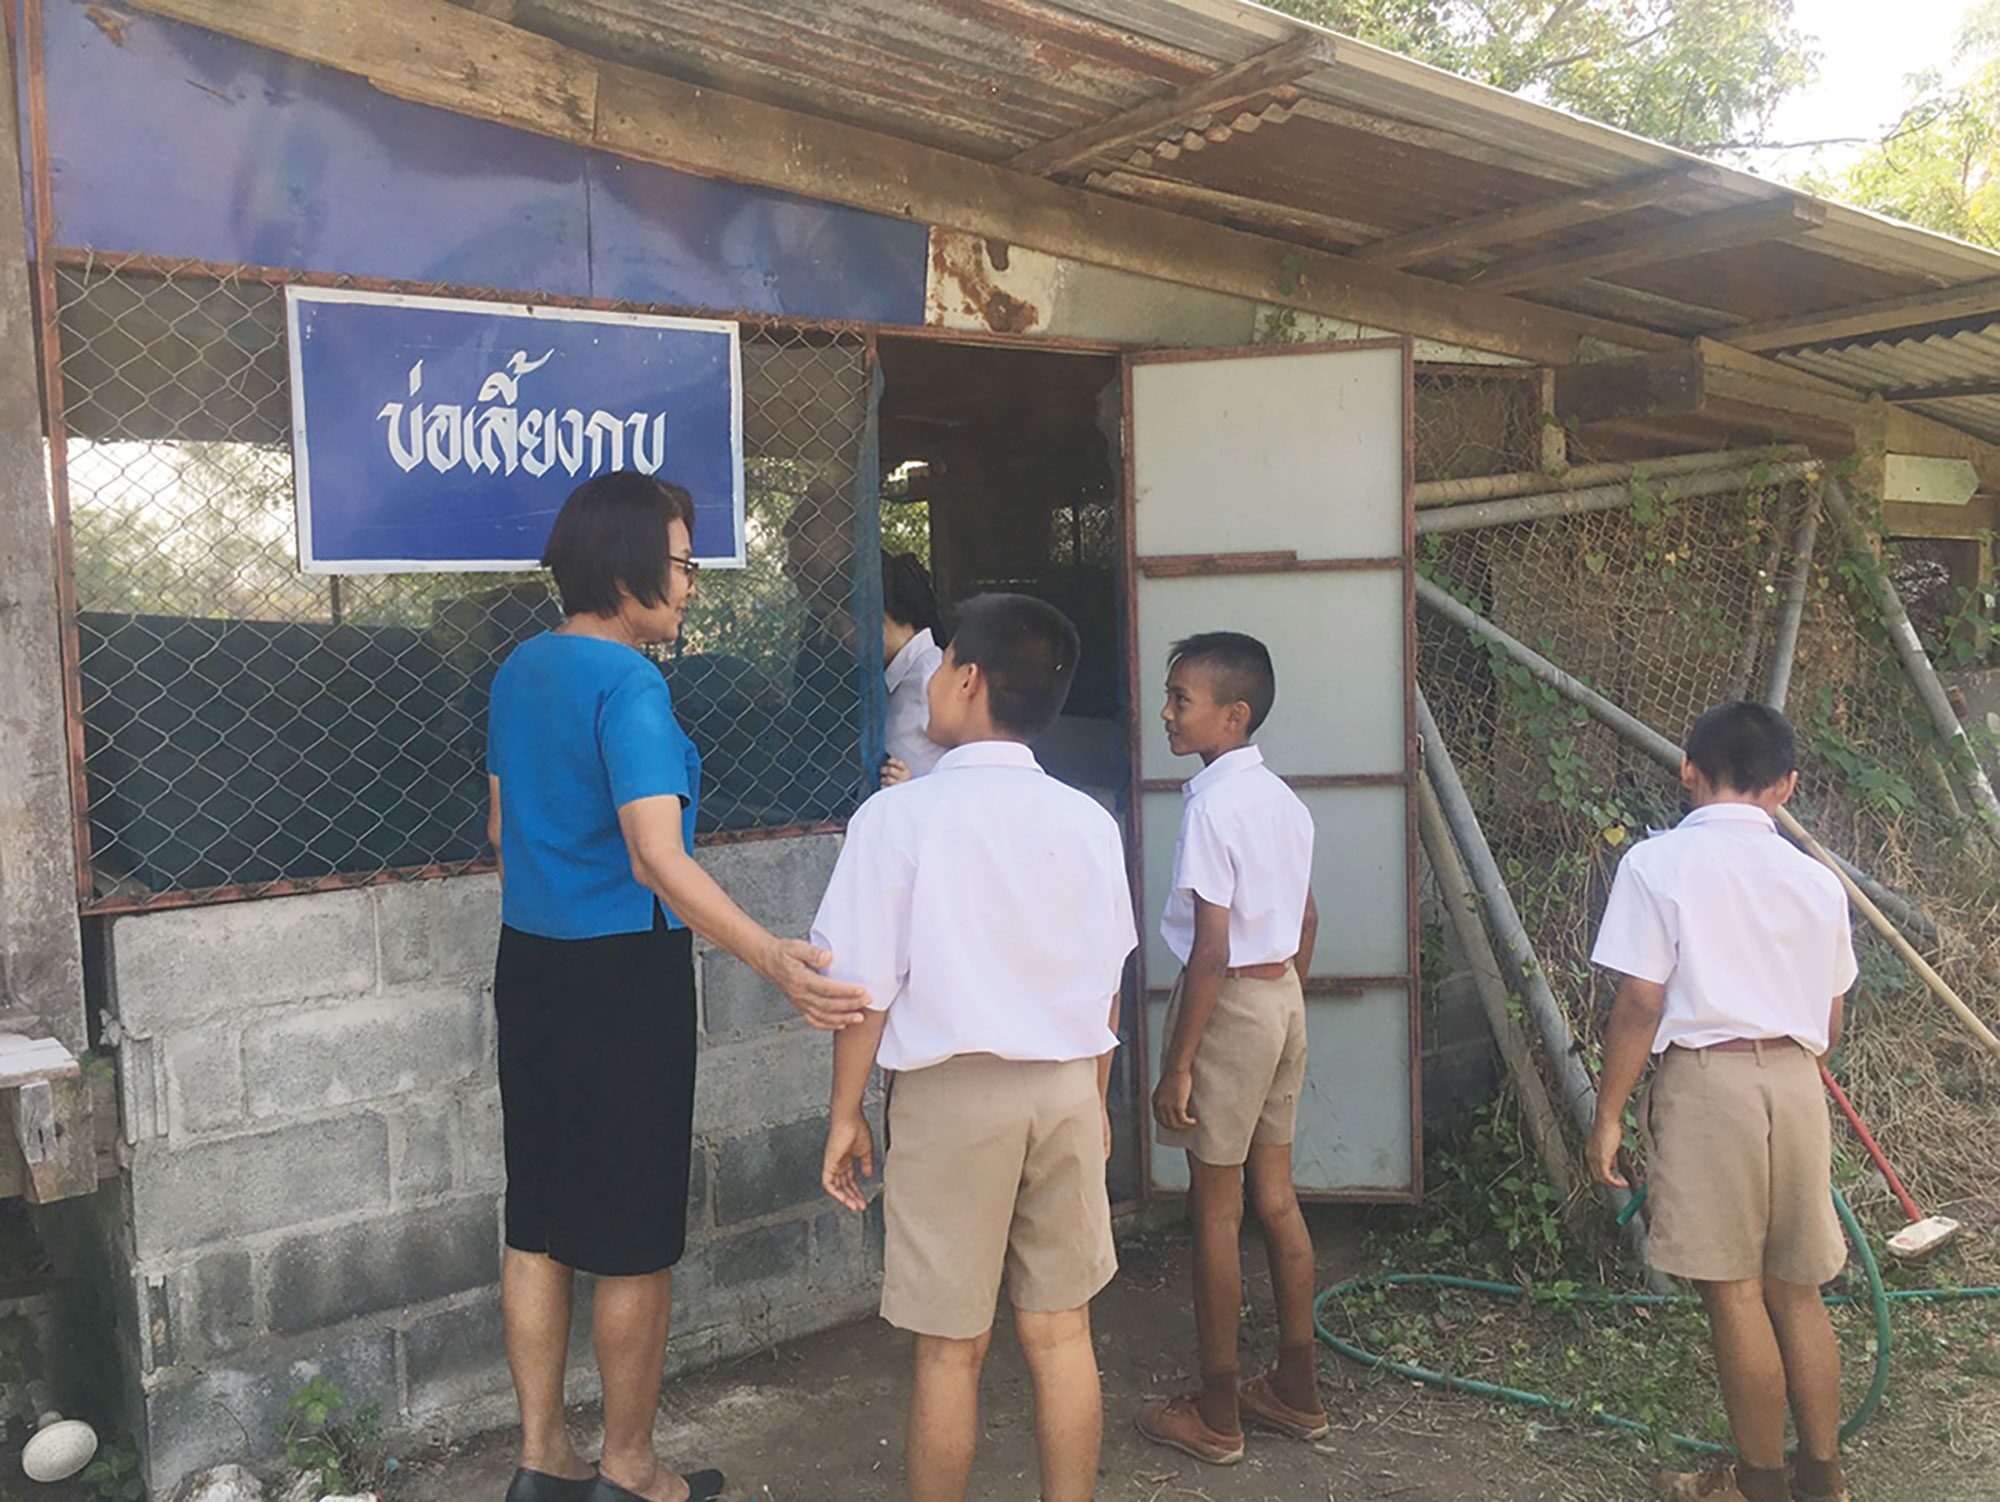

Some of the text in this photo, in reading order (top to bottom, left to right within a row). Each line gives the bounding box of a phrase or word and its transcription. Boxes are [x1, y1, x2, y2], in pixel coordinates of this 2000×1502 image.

[377, 348, 666, 478] บ่อเลี้ยงกบ
